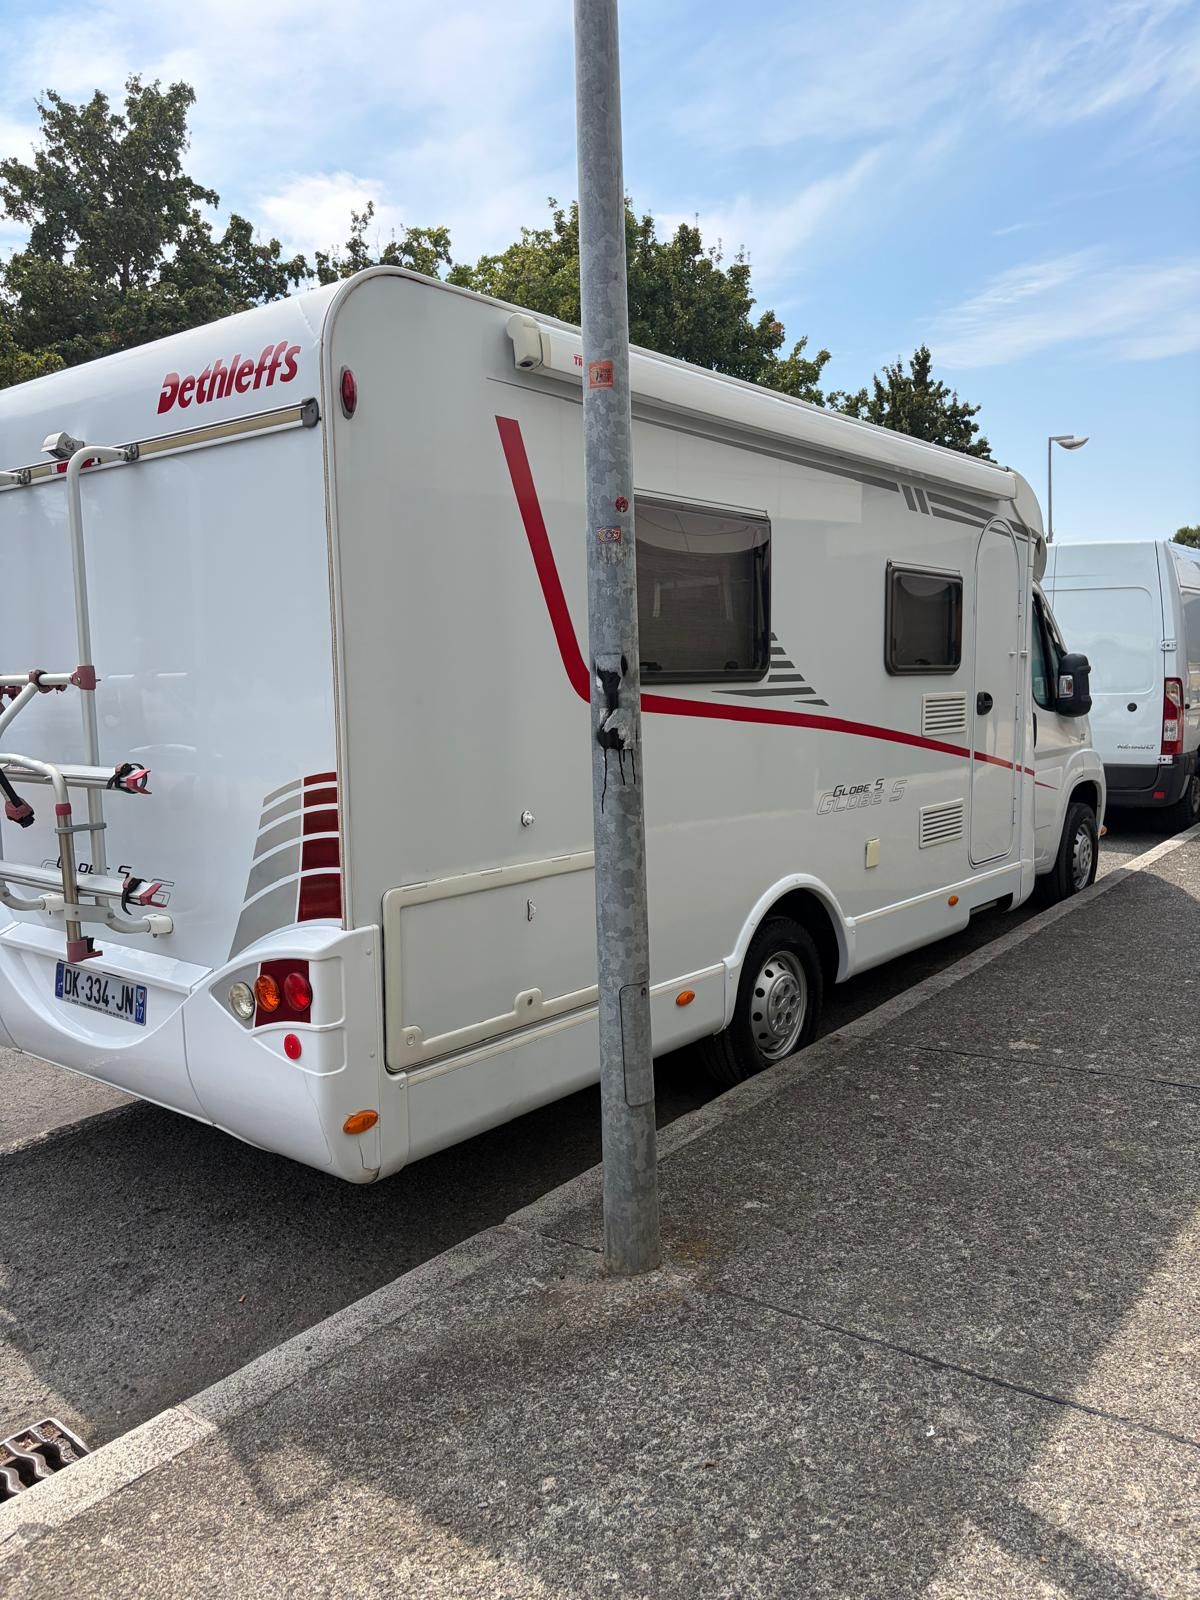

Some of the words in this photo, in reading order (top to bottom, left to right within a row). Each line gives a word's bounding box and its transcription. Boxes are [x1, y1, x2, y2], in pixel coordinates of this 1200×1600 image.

[157, 341, 302, 415] Dethleffs
[832, 783, 871, 798] GLOBE
[874, 778, 885, 791] S
[888, 779, 908, 803] S
[64, 967, 134, 1016] DK-334-JN
